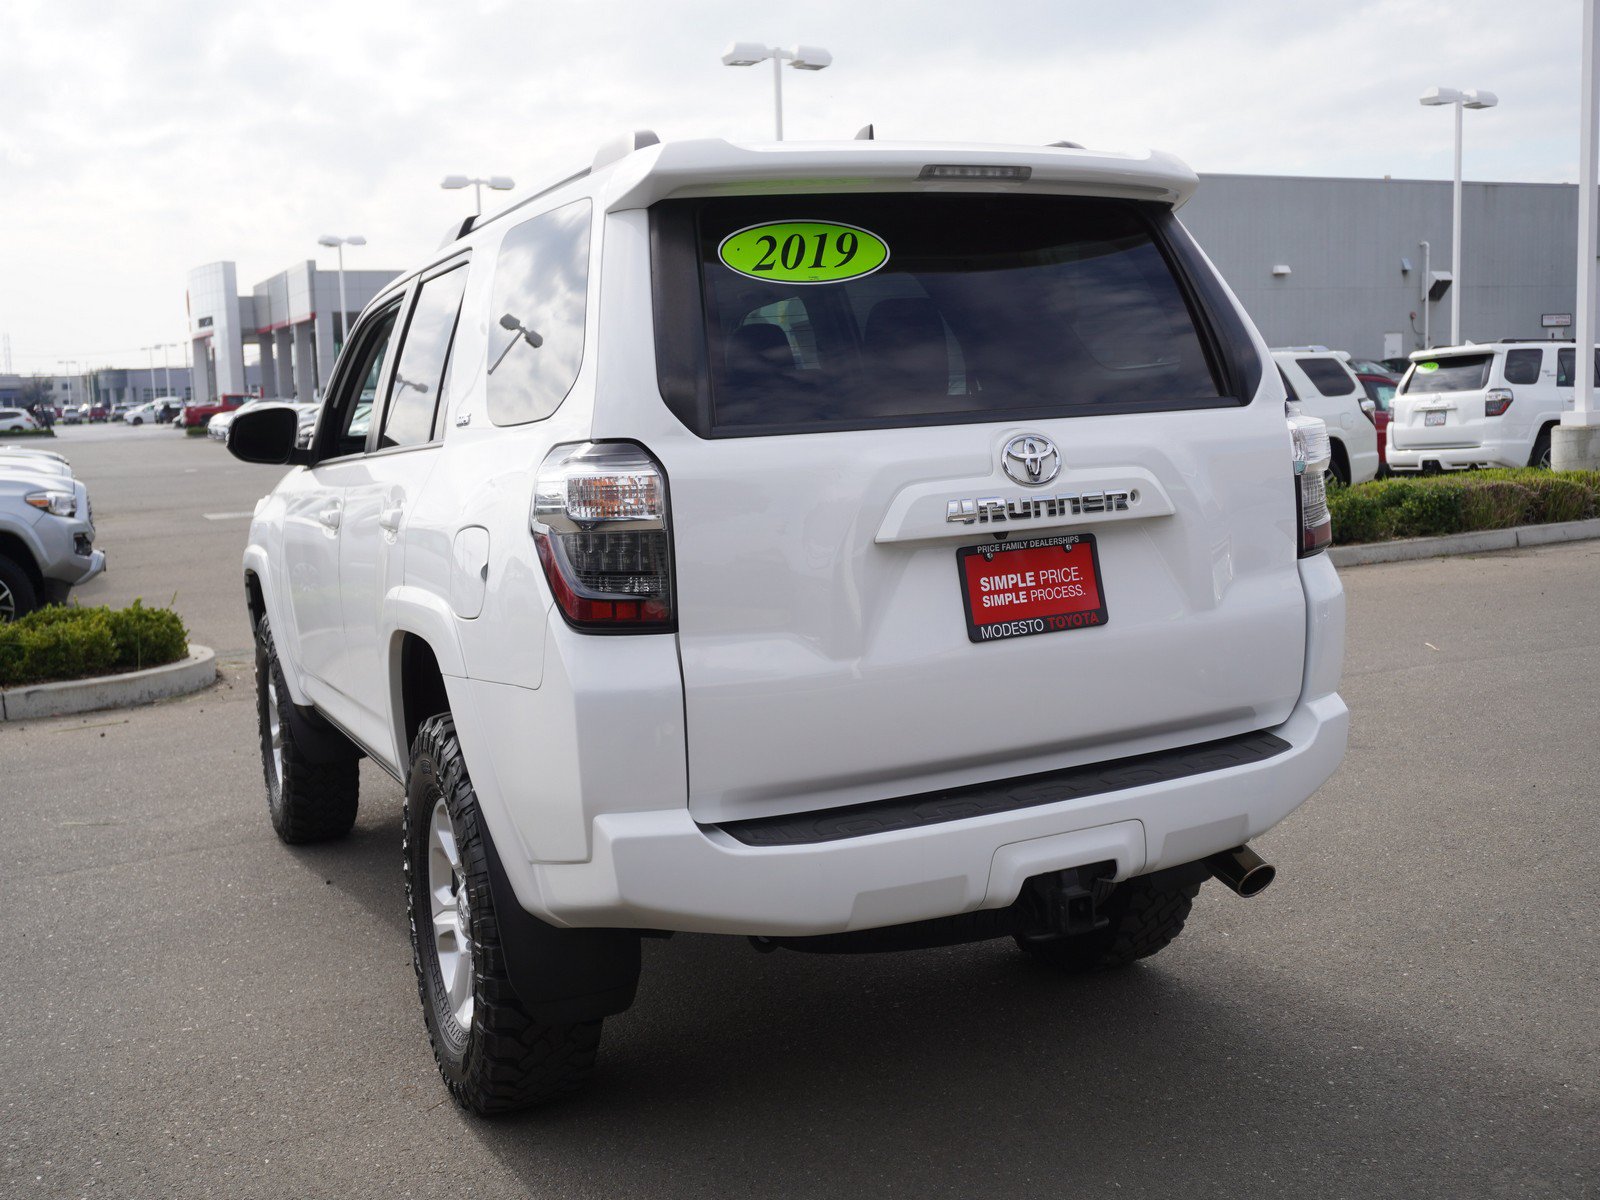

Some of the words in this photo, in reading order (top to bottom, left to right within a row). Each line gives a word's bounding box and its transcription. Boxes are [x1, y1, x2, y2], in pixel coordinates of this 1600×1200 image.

[752, 232, 858, 271] 2019
[977, 545, 1000, 554] PRICE
[1001, 541, 1028, 551] FAMILY
[1029, 535, 1080, 548] DEALERSHIPS
[980, 572, 1035, 592] SIMPLE
[1039, 566, 1083, 585] PRICE.
[982, 591, 1028, 608] SIMPLE
[1030, 584, 1086, 602] PROCESS.
[980, 618, 1044, 639] MODESTO
[1047, 612, 1099, 630] TOYOTA
